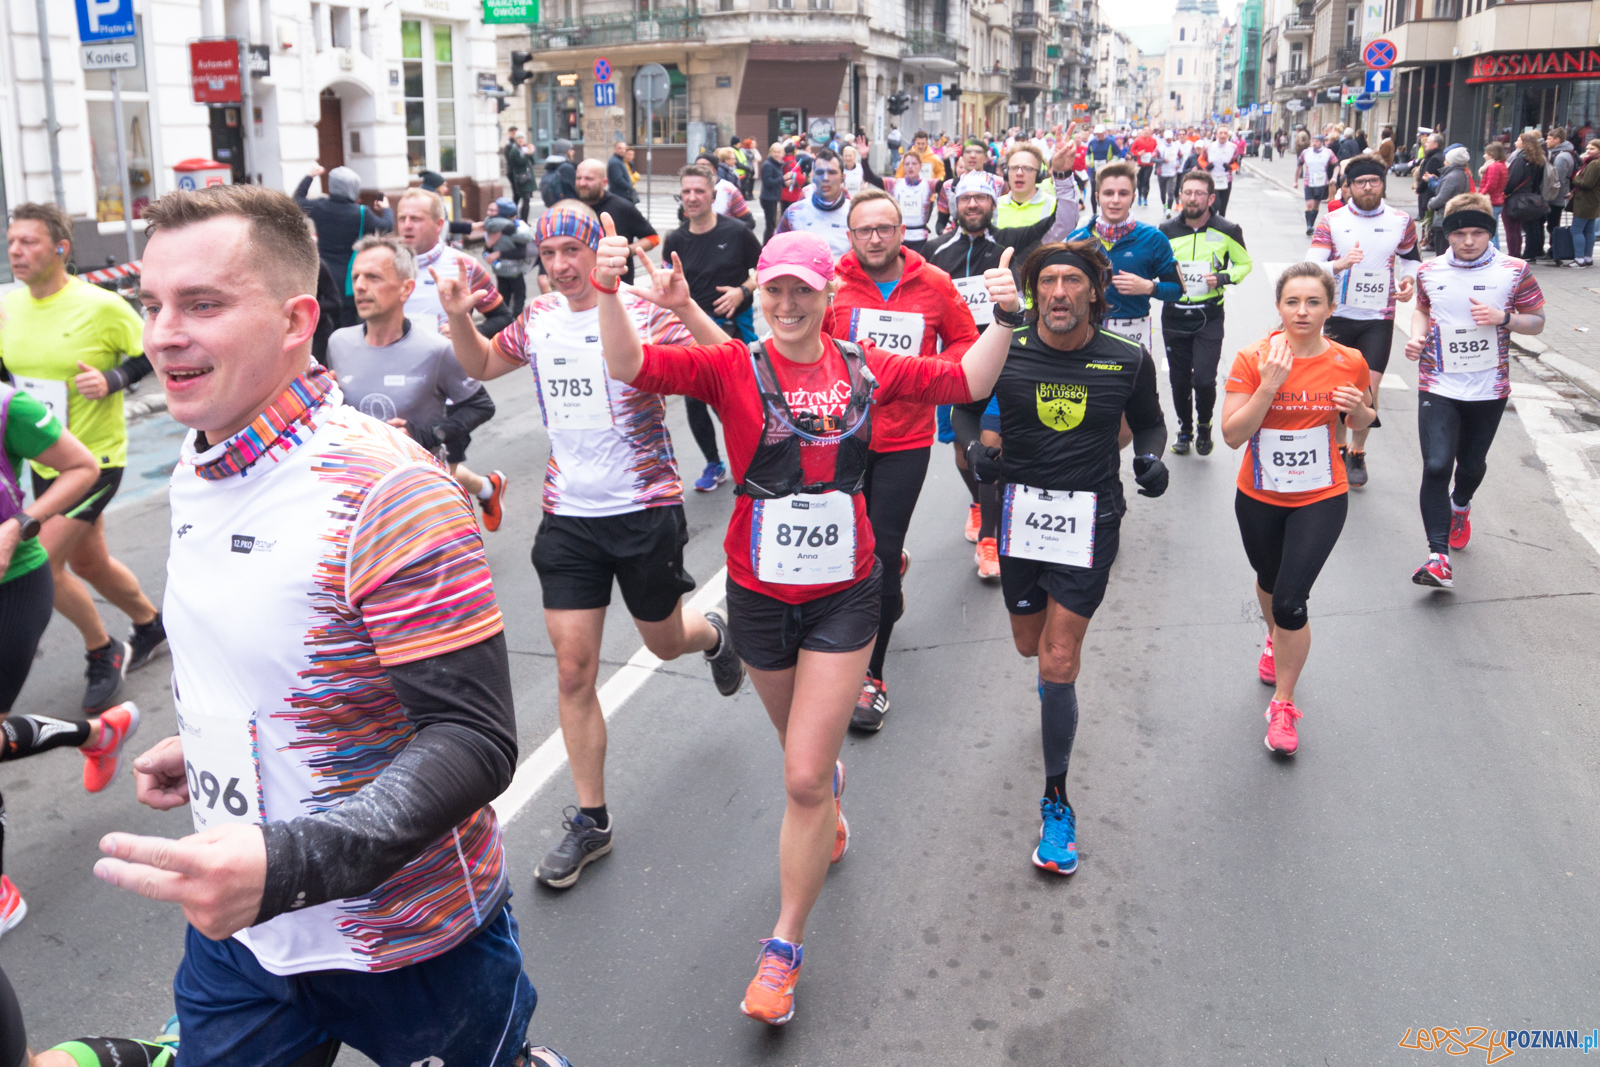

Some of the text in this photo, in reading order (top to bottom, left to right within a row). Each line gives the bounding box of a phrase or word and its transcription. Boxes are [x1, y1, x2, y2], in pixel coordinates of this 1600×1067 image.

[493, 6, 527, 17] OWOCE
[85, 50, 129, 64] Koniec
[198, 60, 233, 69] Automat
[1355, 282, 1384, 293] 5565
[868, 331, 912, 350] 5730
[1449, 339, 1489, 354] 8382
[1085, 363, 1122, 371] FABIO
[547, 378, 593, 397] 3783
[1040, 382, 1085, 393] BARBONI
[1040, 389, 1085, 400] DI LUSSO
[1272, 449, 1317, 467] 8321
[1025, 512, 1076, 534] 4221
[776, 523, 839, 548] 8768
[233, 539, 253, 549] 12.PKO
[186, 760, 248, 816] 096
